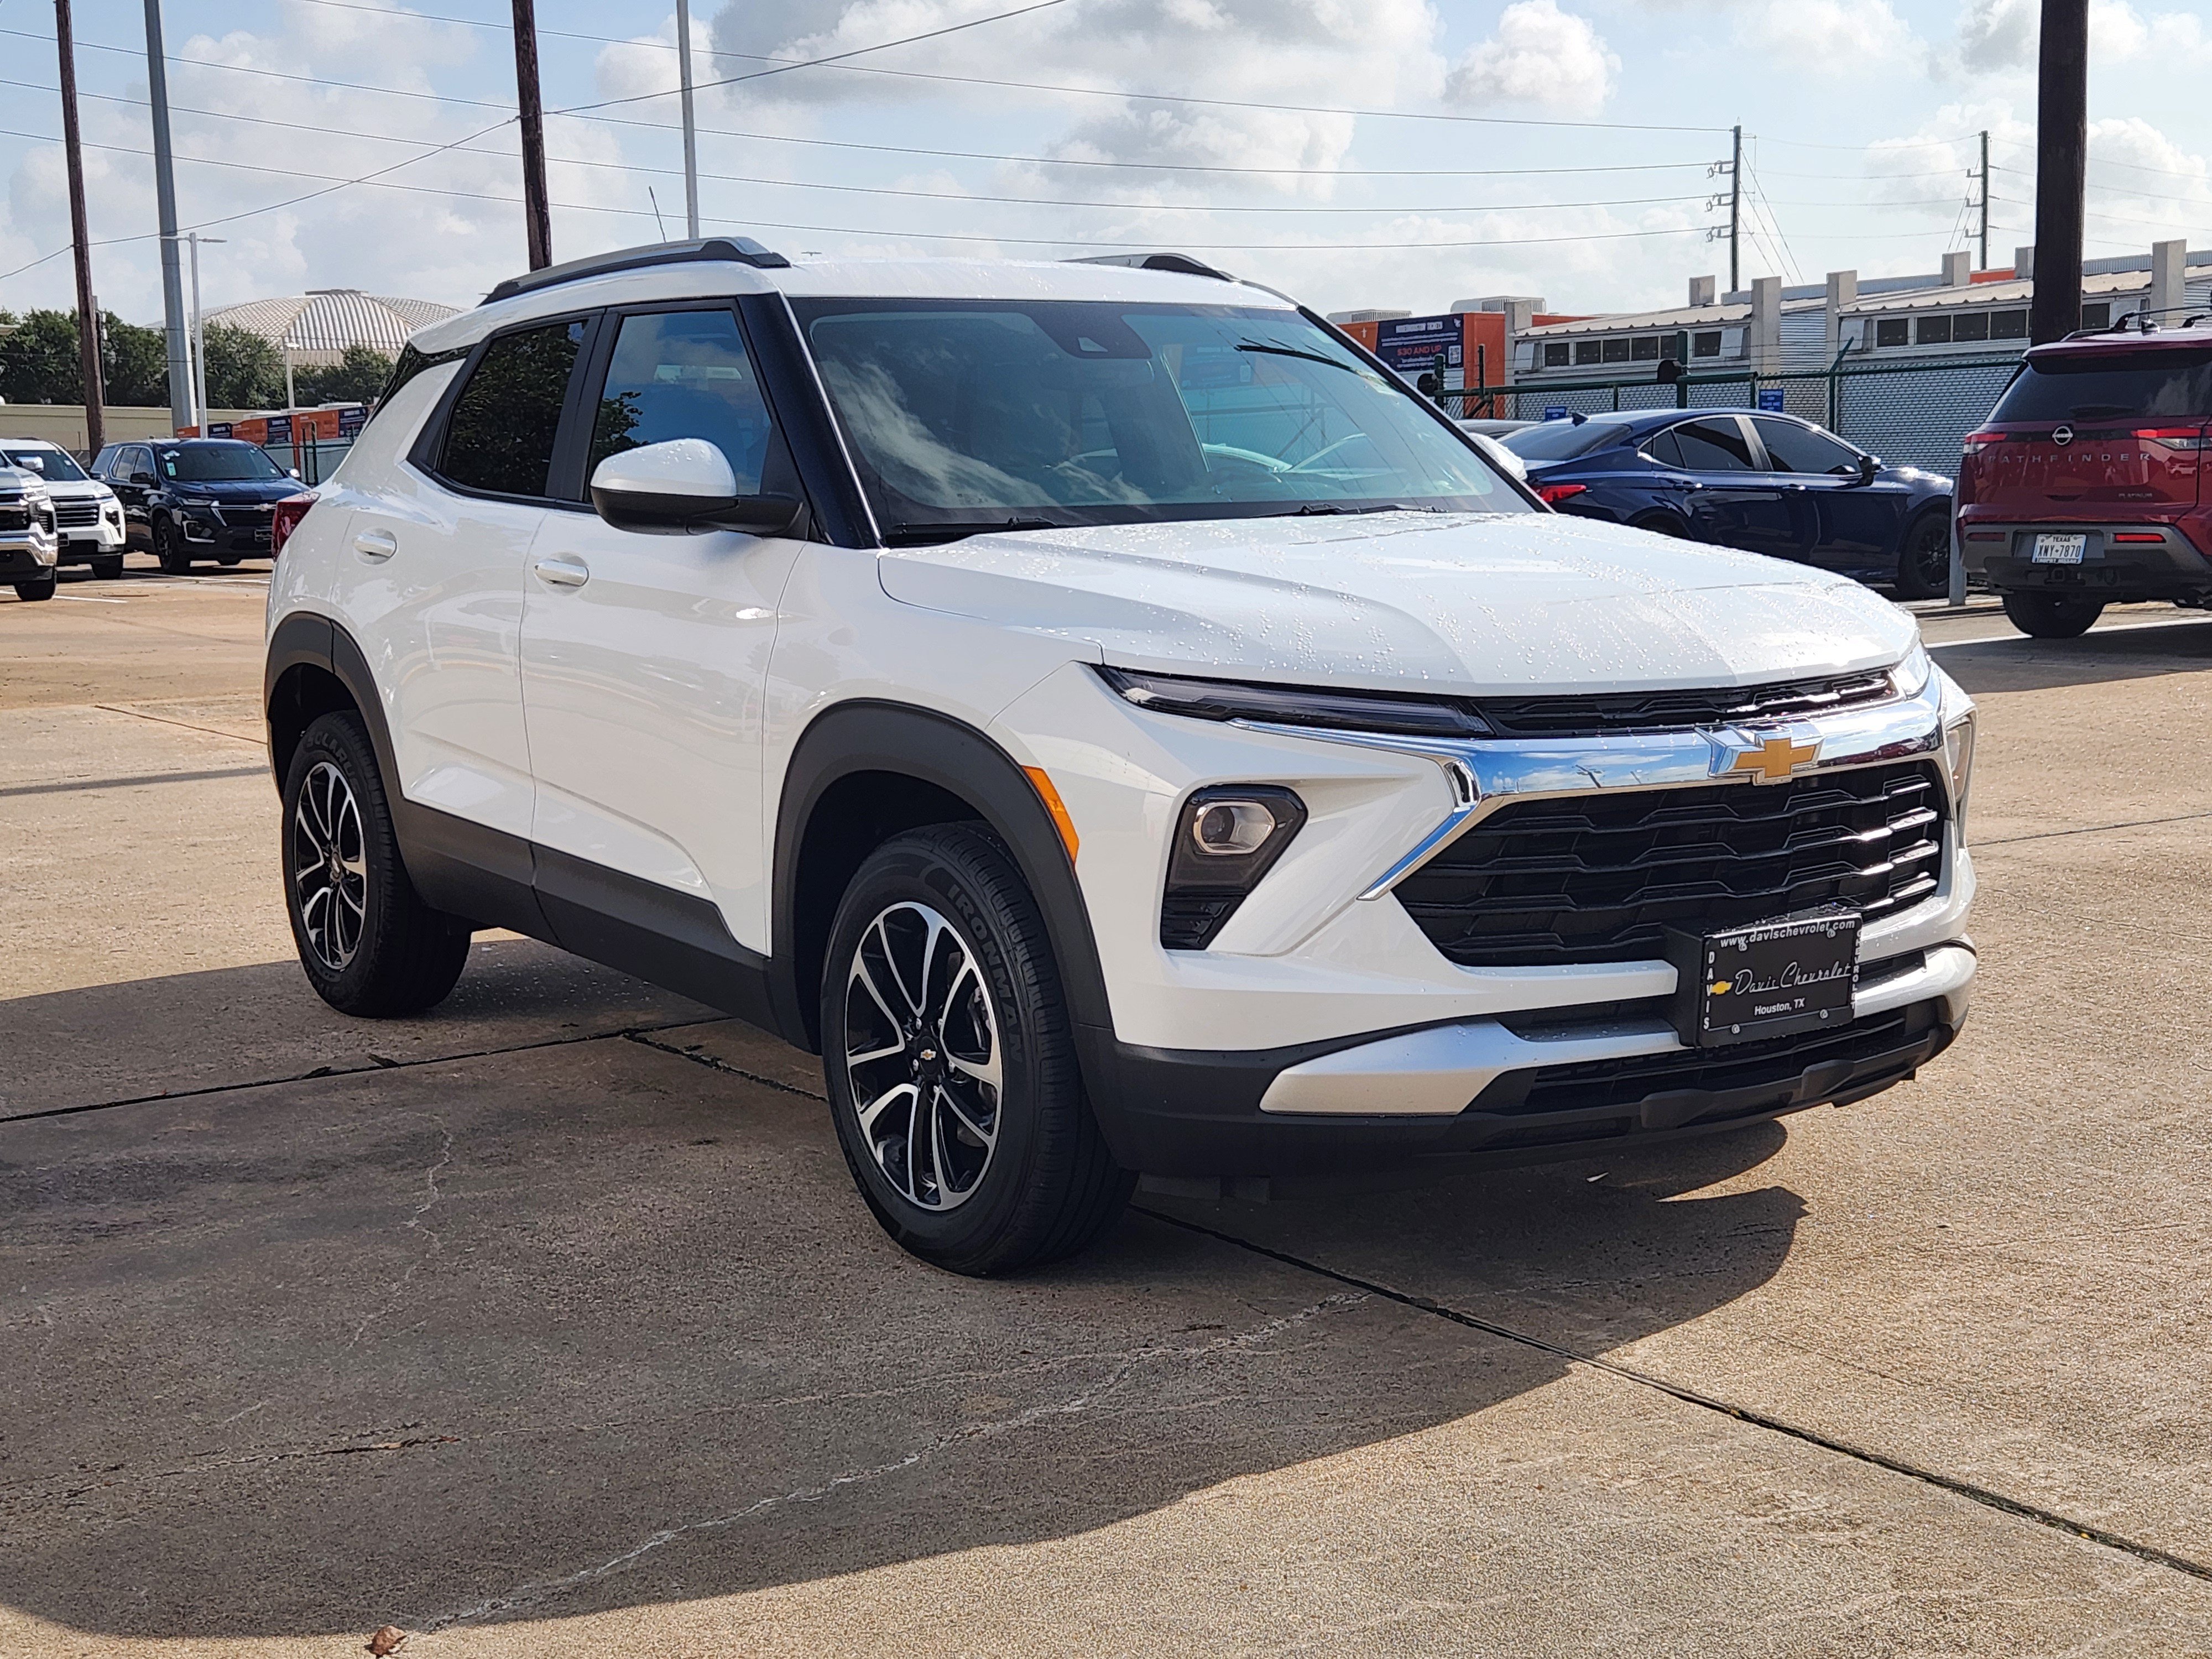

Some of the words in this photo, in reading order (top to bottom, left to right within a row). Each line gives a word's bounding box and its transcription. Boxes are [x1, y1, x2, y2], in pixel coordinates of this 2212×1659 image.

[1397, 347, 1412, 356] $30
[1413, 346, 1430, 354] AND
[1431, 345, 1442, 353] UP
[1987, 453, 2151, 464] PATHFINDER
[1720, 920, 1855, 948] www.davischevrolet.com
[947, 884, 1022, 1063] IRONMAN
[1735, 968, 1780, 995] Davis
[1781, 961, 1851, 988] Chevrolet
[1703, 951, 1715, 1030] DAVIS
[1754, 1002, 1792, 1016] Houston,
[1793, 997, 1806, 1009] TX
